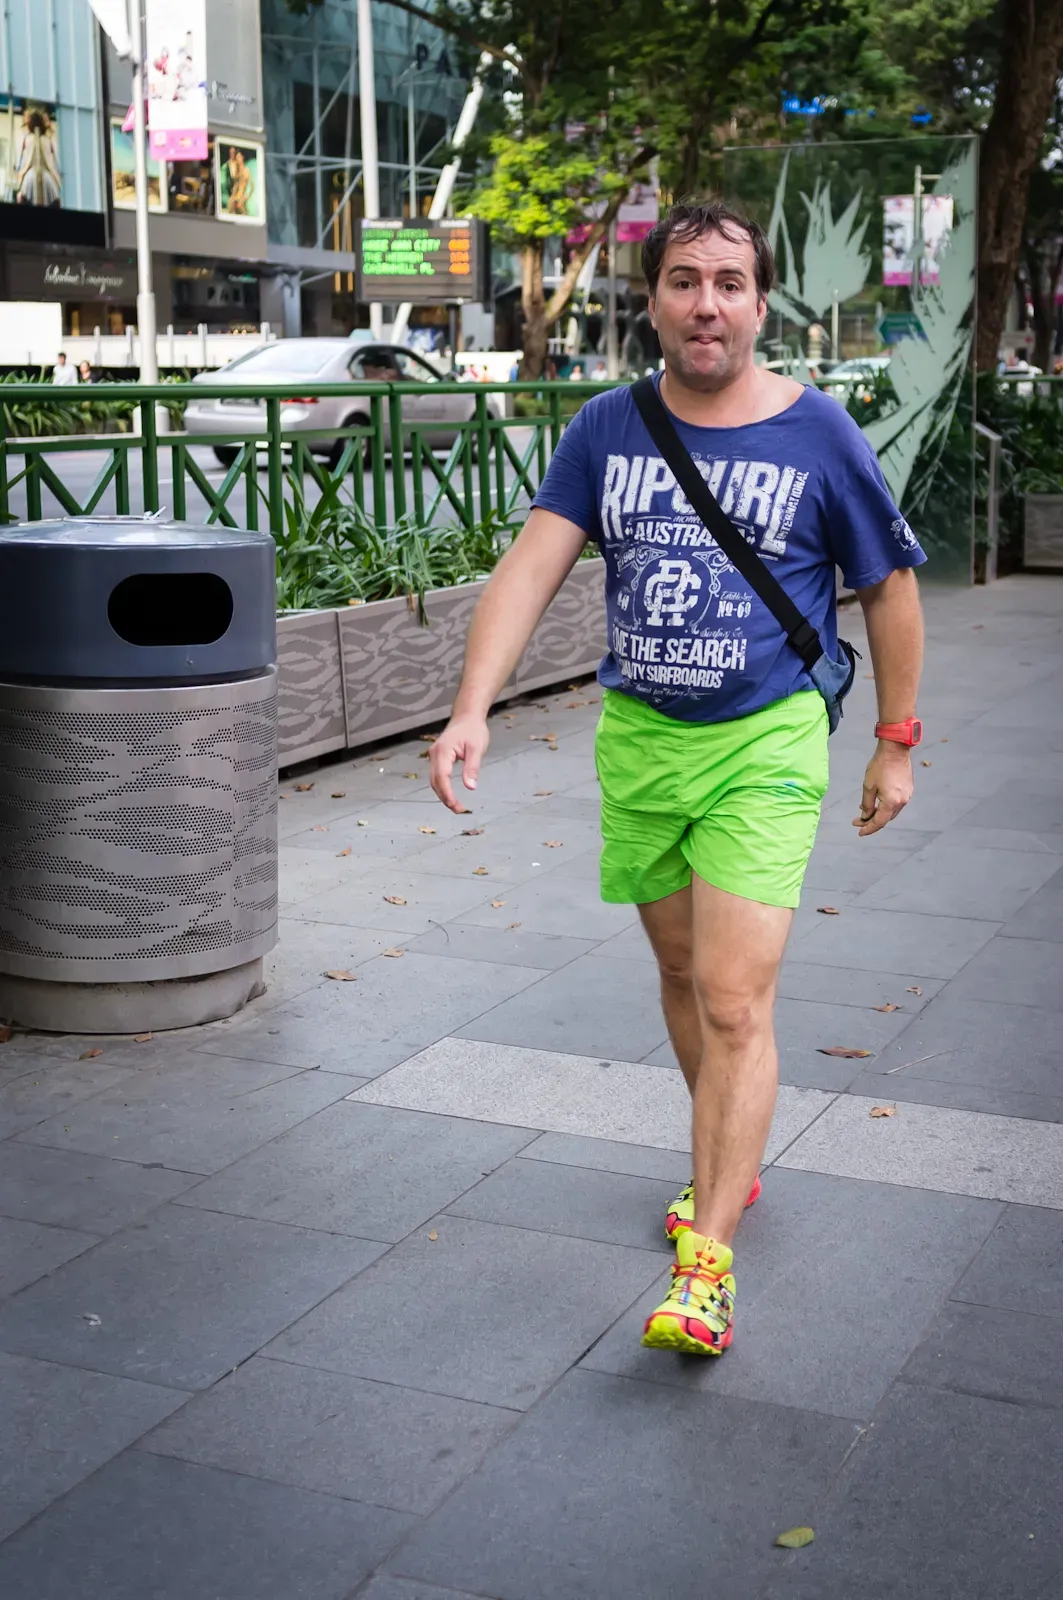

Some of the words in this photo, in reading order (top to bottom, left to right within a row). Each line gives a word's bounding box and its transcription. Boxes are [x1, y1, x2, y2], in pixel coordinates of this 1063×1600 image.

[630, 633, 663, 662] THE
[664, 637, 748, 671] SEARCH
[646, 665, 724, 689] SURFBOARDS
